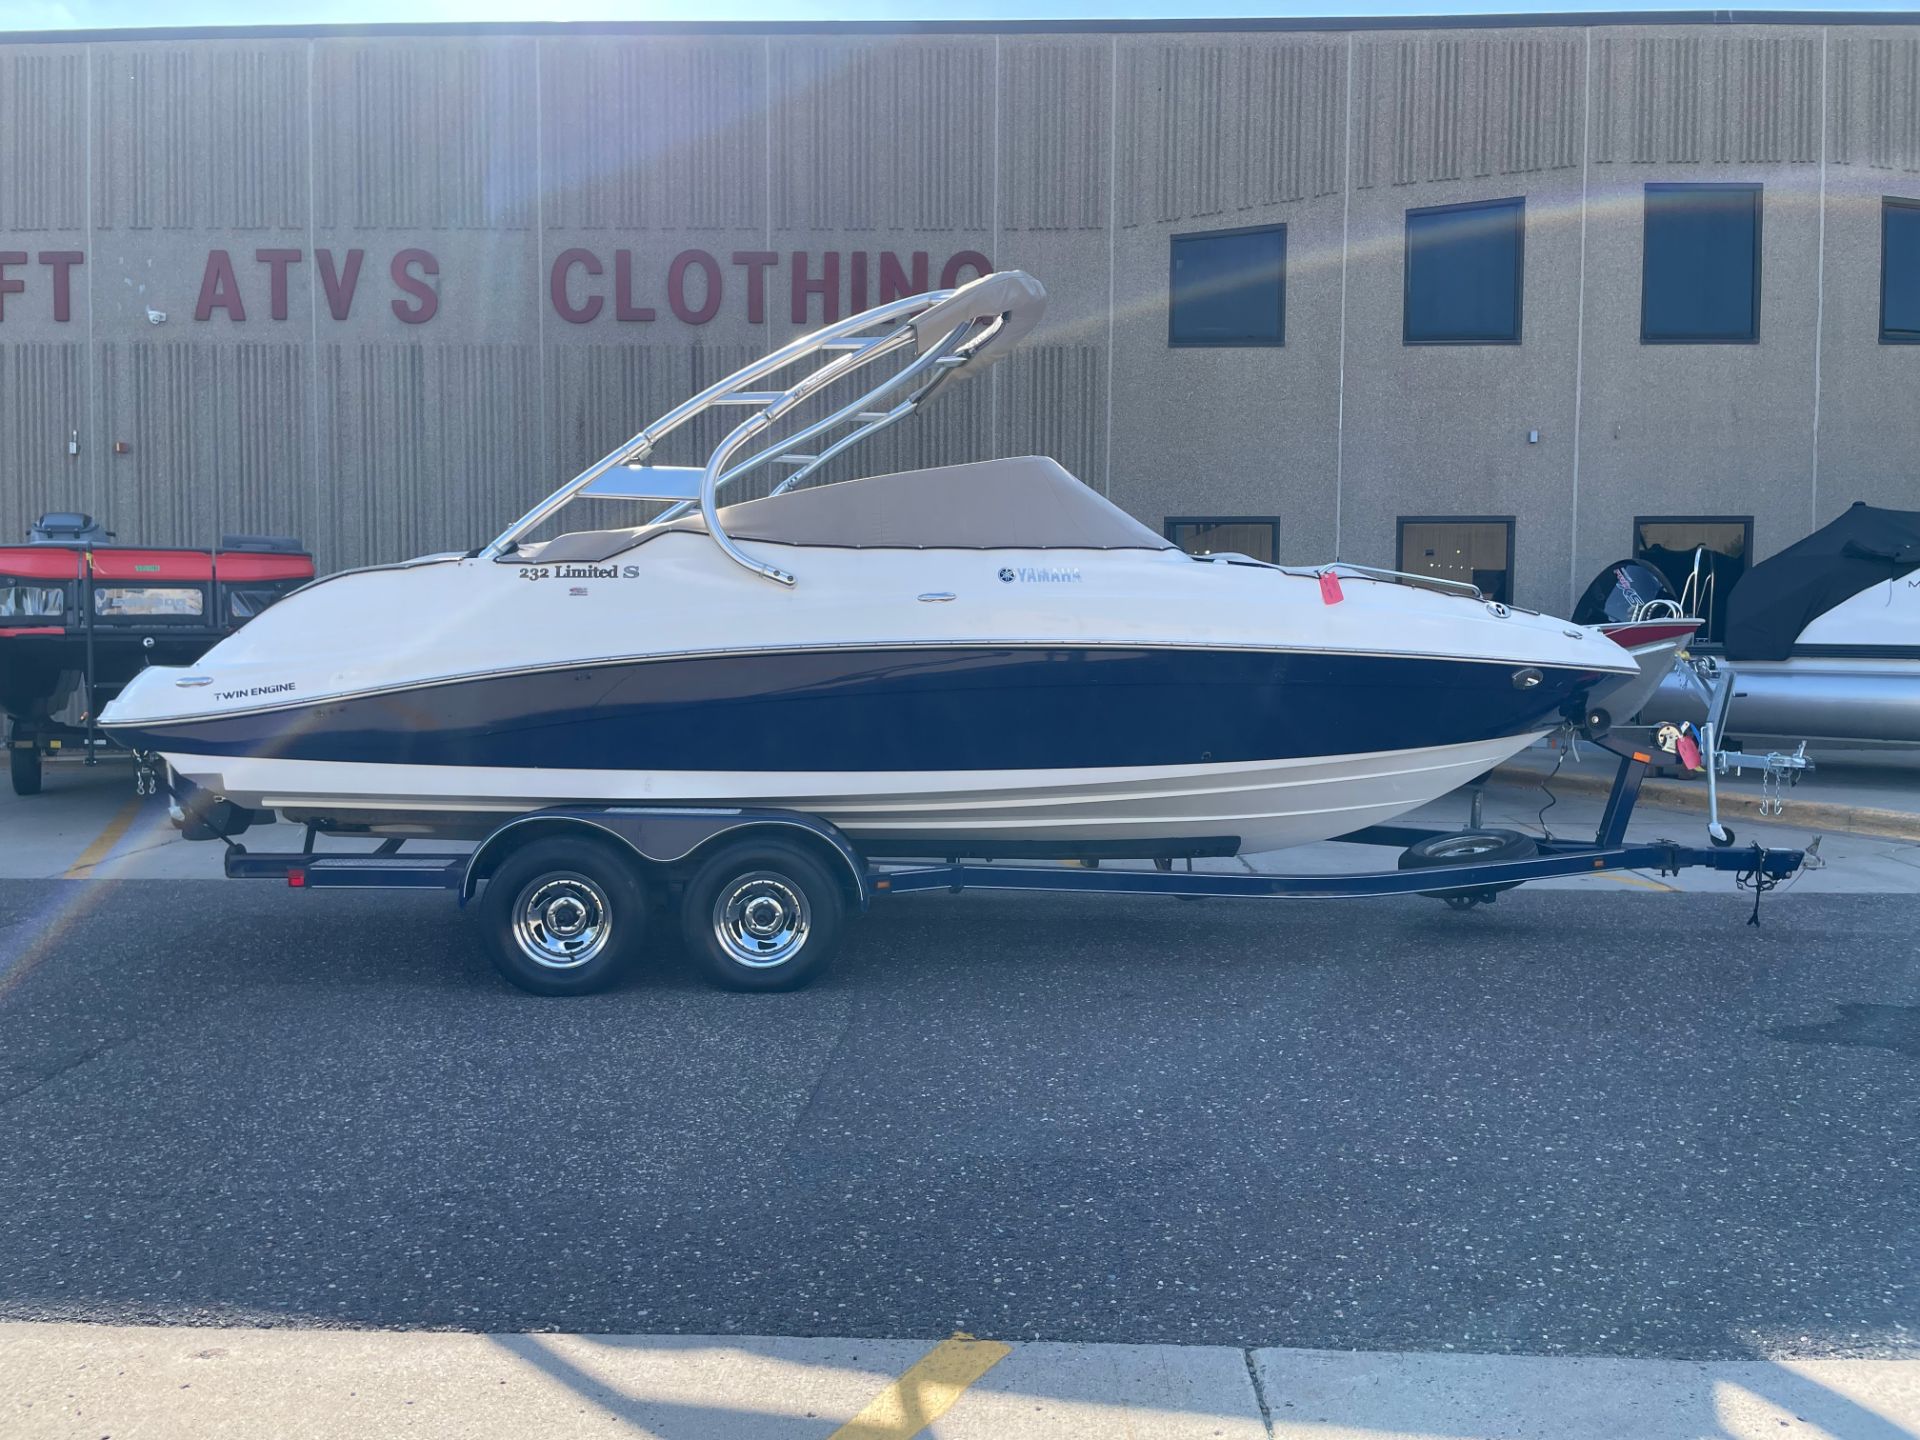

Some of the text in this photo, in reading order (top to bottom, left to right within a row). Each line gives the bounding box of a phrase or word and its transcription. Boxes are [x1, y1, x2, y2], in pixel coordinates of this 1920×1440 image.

[194, 248, 440, 323] ATVS
[519, 565, 640, 581] 232 Limited S
[1017, 567, 1081, 583] YAMAHA
[214, 682, 296, 701] TWIN ENGINE
